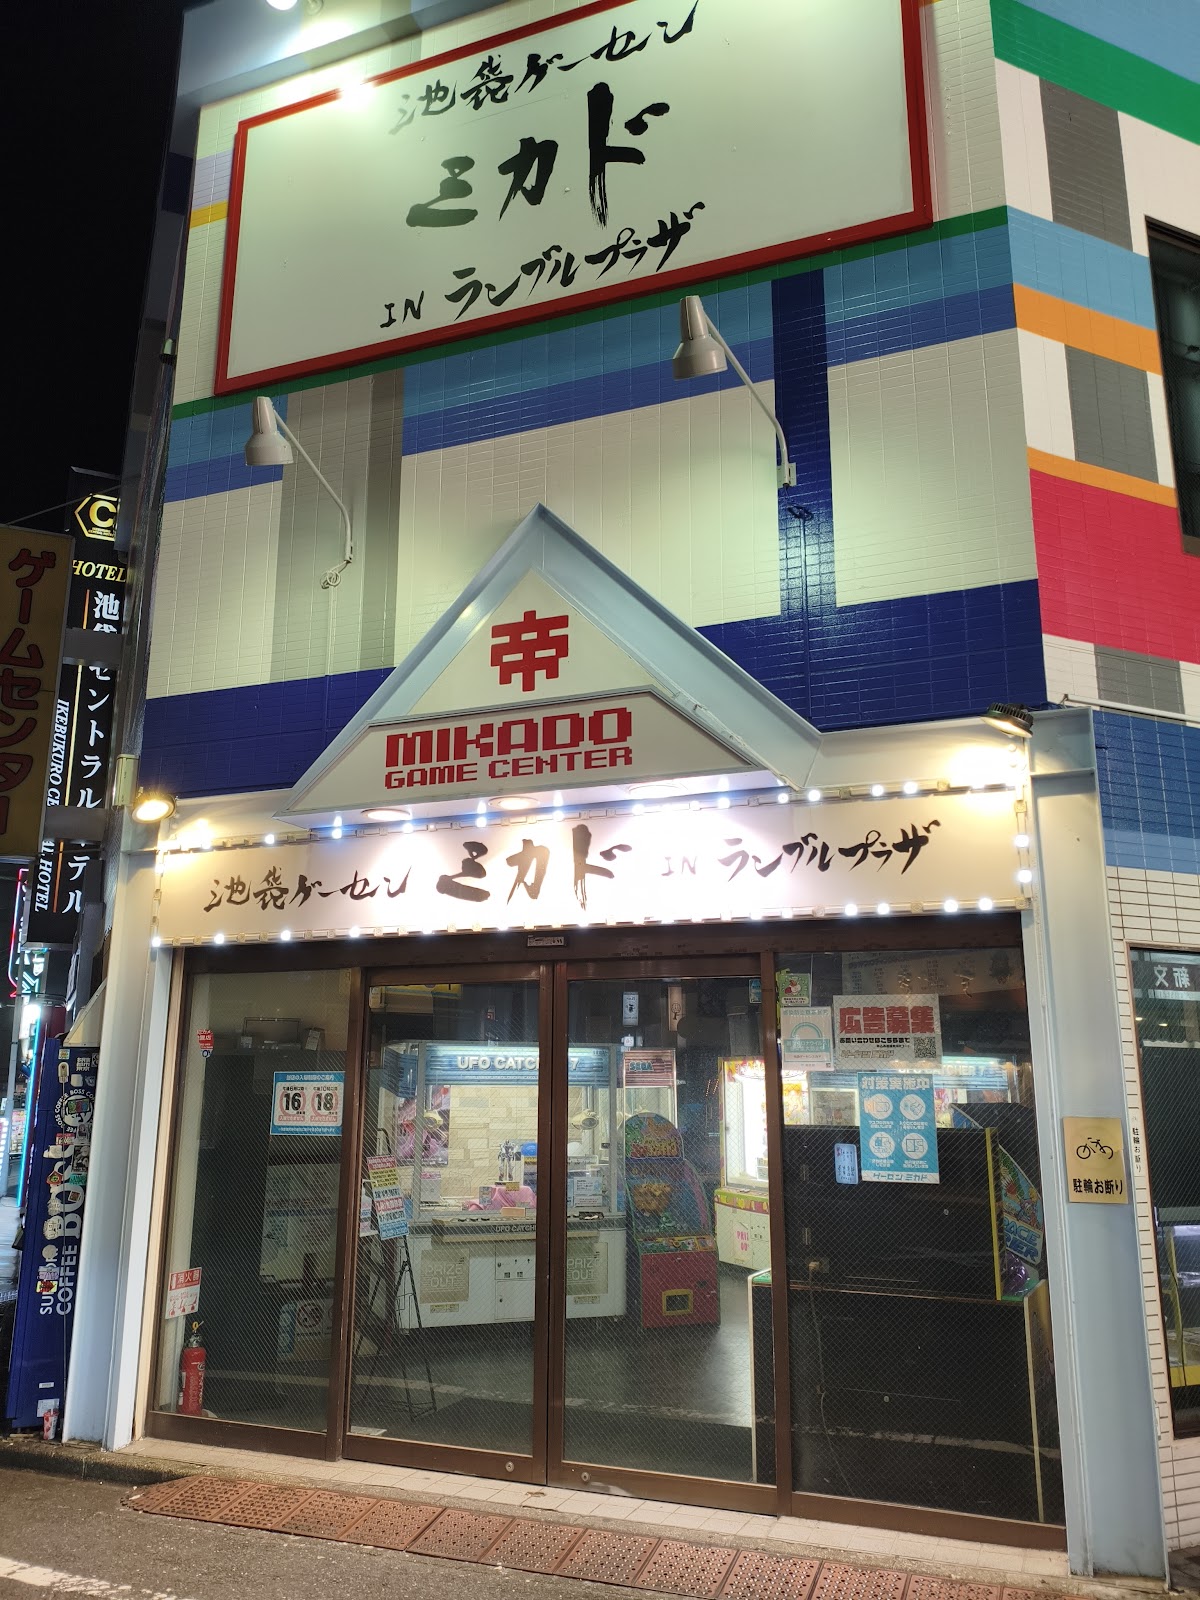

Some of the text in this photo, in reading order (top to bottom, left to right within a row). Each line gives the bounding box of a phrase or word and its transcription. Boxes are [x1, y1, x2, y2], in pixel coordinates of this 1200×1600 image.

[388, 0, 699, 134] 池袋ゲーセン
[405, 82, 670, 228] ミカド
[379, 202, 705, 328] IN ランブルプラザ
[50, 698, 70, 785] IKEBUKURO
[386, 707, 632, 767] MIKADO
[385, 746, 633, 789] GAME CENTER
[35, 858, 53, 912] HOTEL
[204, 819, 941, 913] 池袋ゲーセン ミカド IN ランブルプラザ
[839, 1005, 935, 1034] 広告募集
[456, 1055, 580, 1071] UFO CATC 7
[284, 1092, 334, 1112] 16 18
[1072, 1178, 1124, 1195] 駐輪お断り
[56, 1244, 78, 1316] COFFEE
